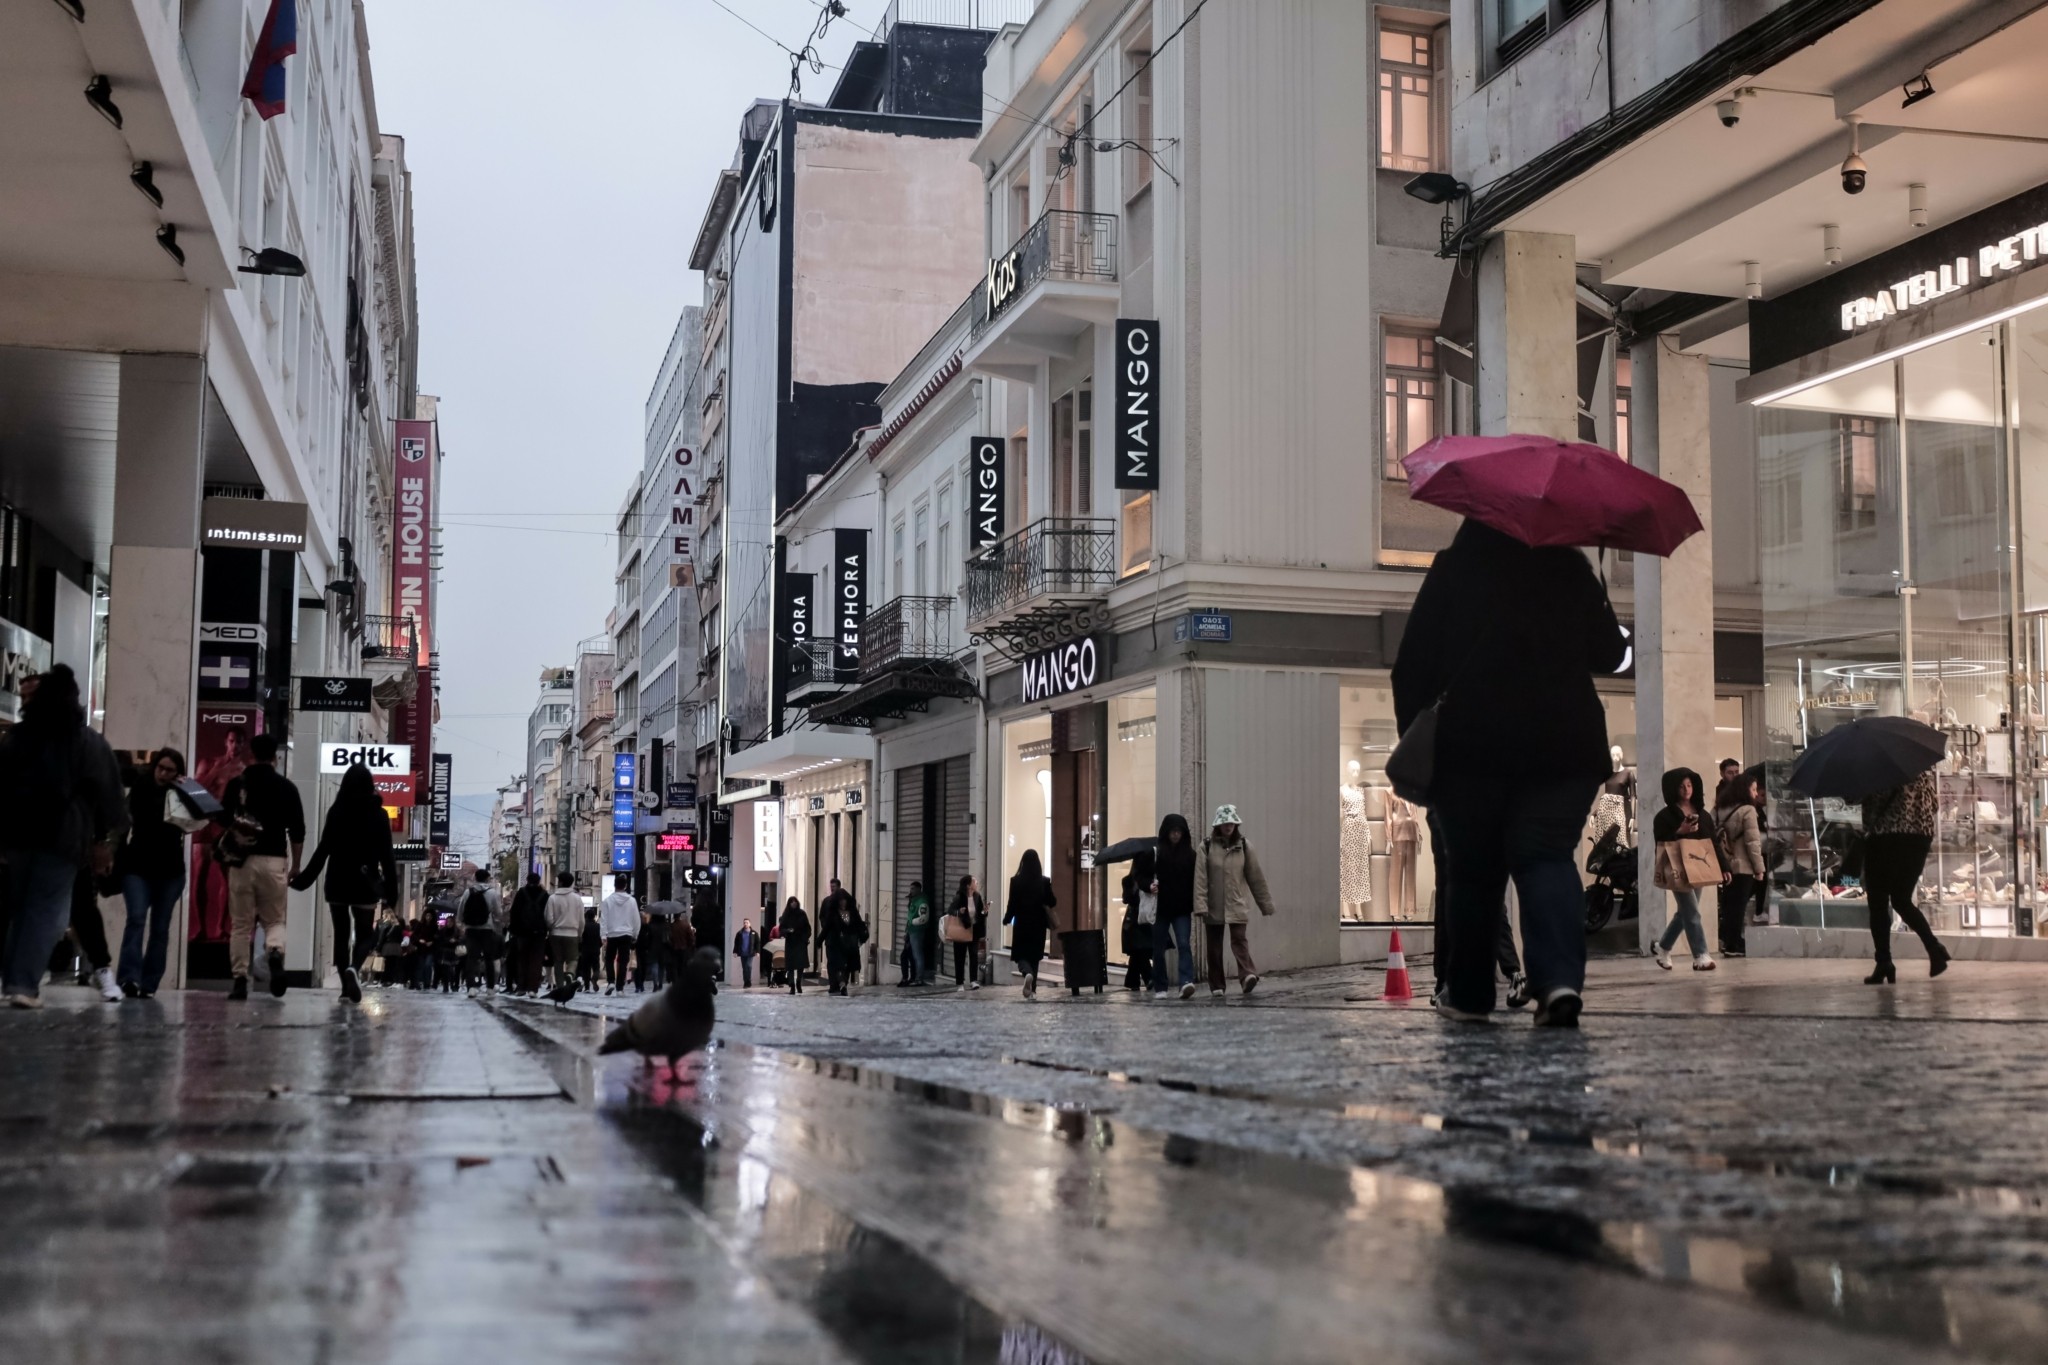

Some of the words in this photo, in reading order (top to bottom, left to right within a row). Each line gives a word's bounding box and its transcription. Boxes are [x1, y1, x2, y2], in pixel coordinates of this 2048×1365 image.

[1841, 257, 1970, 331] FRATELLI
[1127, 328, 1149, 477] MANGO
[401, 477, 424, 564] HOUSE
[979, 443, 997, 560] MANGO
[201, 626, 258, 639] MED
[843, 554, 859, 657] SEPHORA
[1022, 636, 1097, 704] MANGO
[202, 713, 247, 724] MED
[434, 762, 449, 792] DUNK
[434, 794, 447, 822] SLAM
